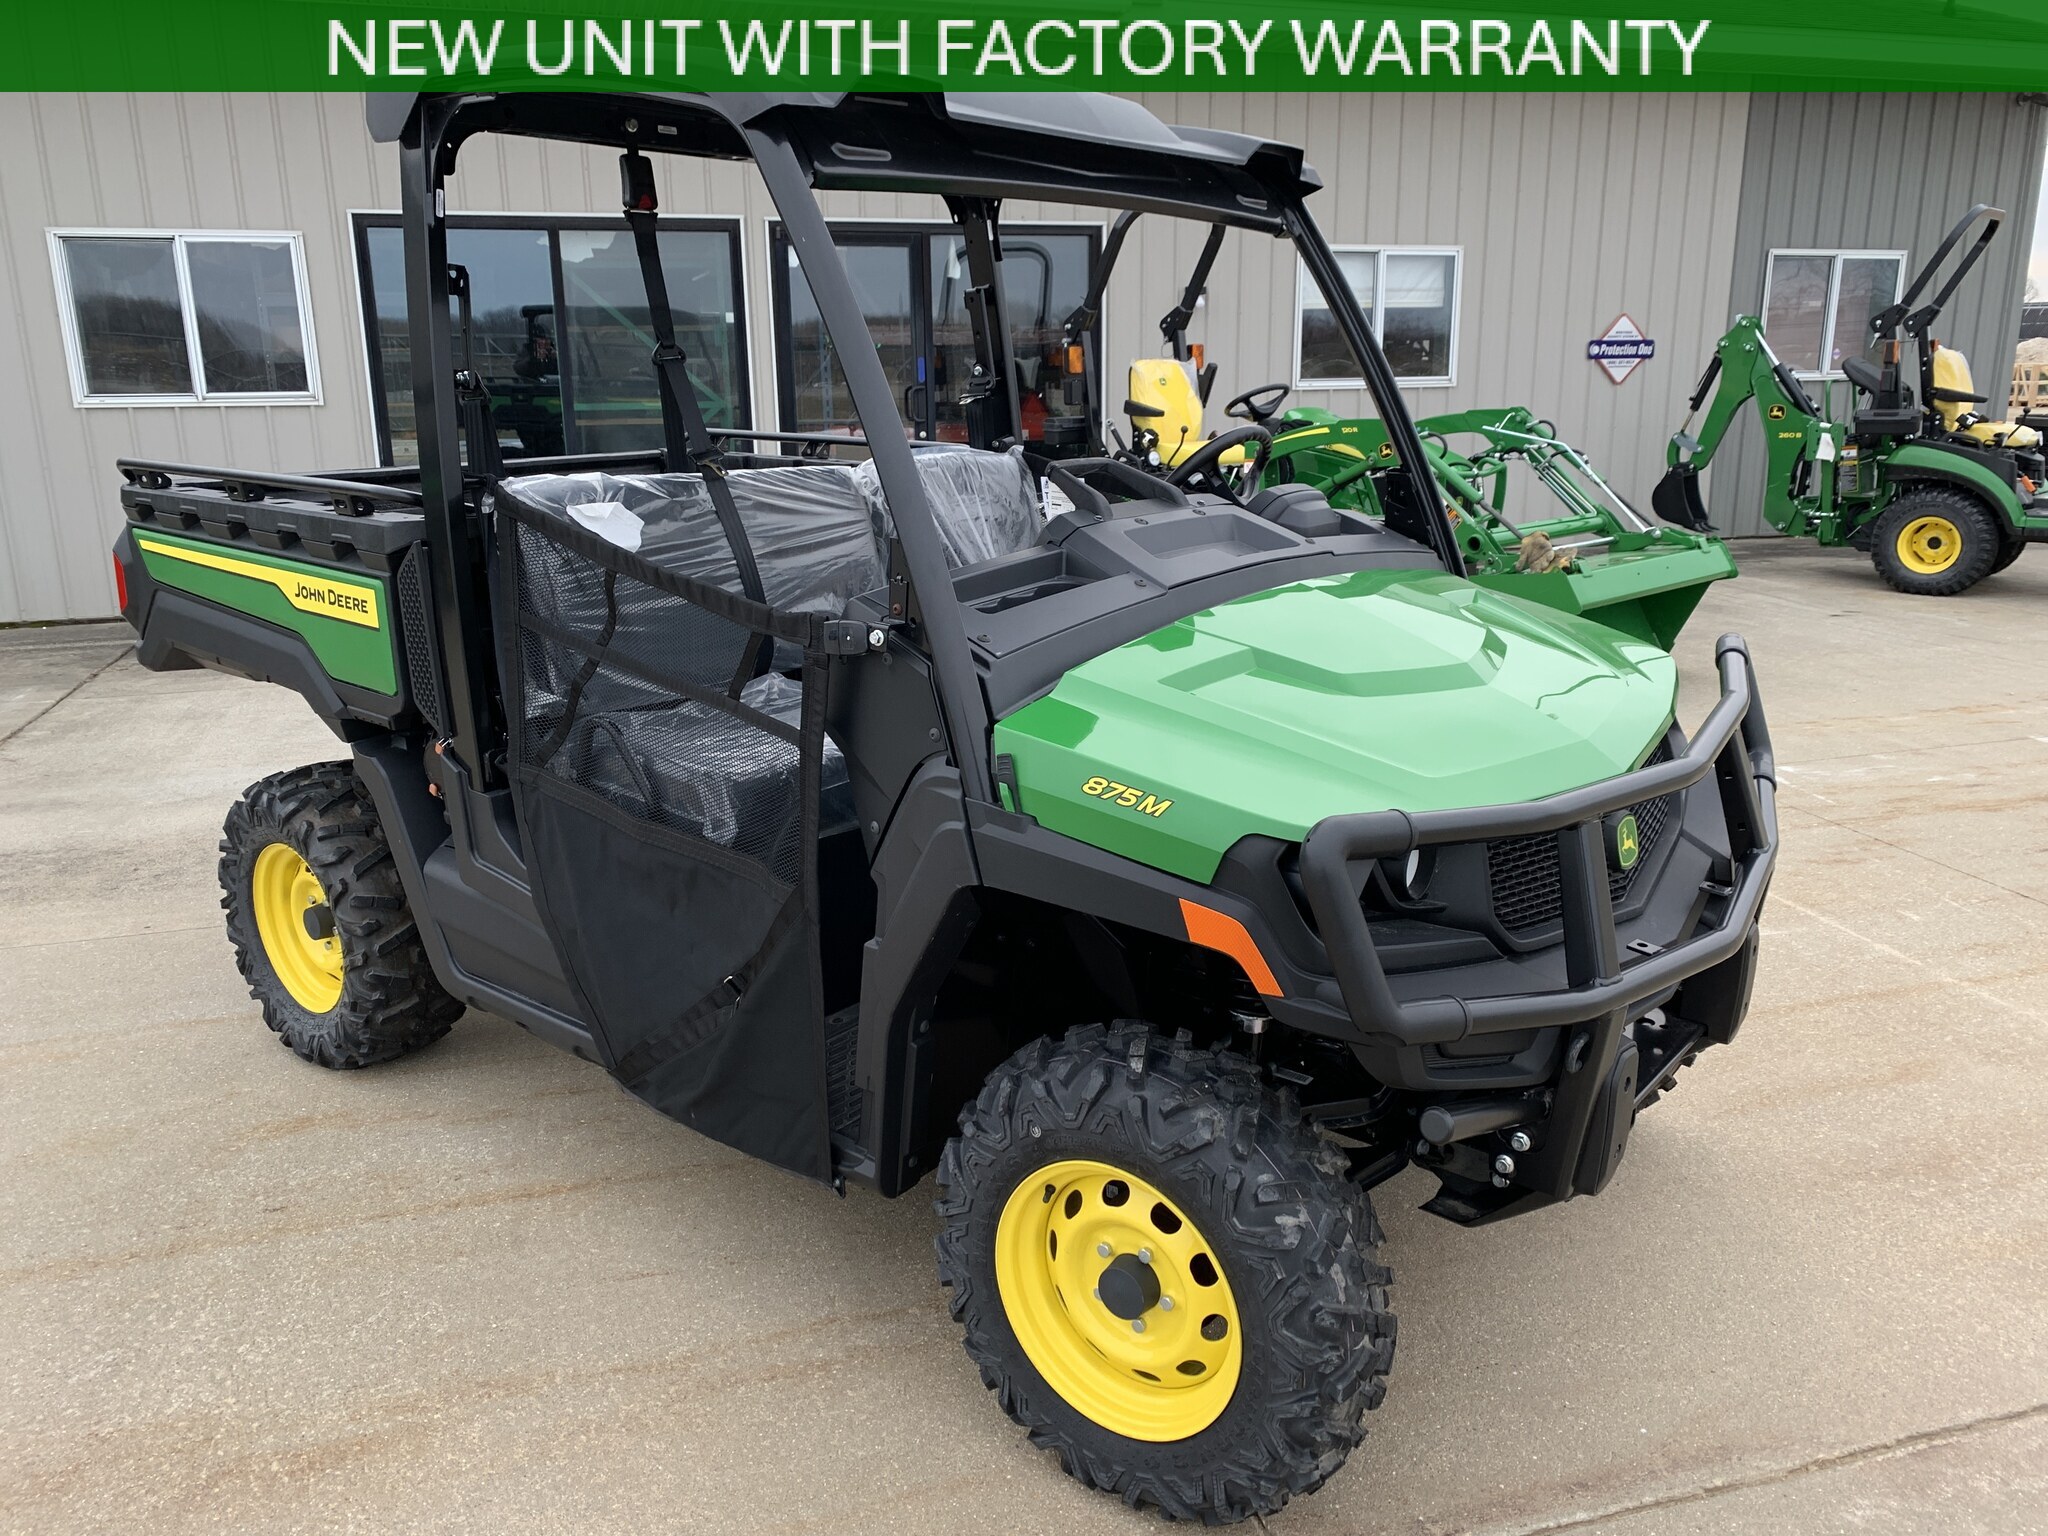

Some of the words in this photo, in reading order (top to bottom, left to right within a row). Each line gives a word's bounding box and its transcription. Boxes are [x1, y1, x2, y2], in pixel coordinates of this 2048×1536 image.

[1599, 343, 1638, 356] Protection
[1637, 343, 1653, 355] One
[294, 581, 326, 604] JOHN
[327, 588, 369, 614] DEERE
